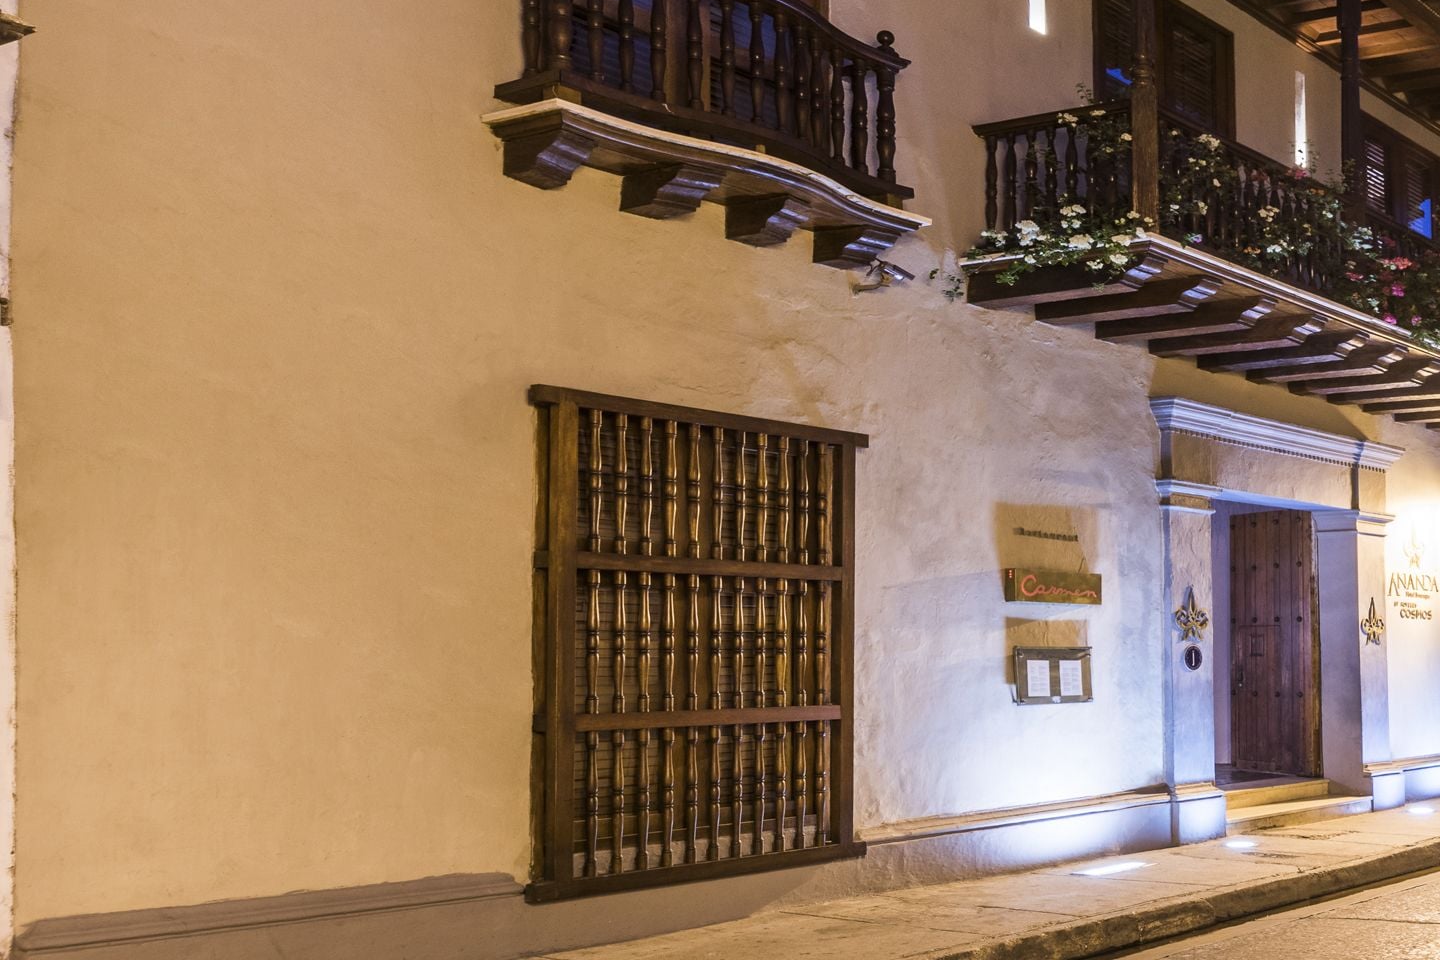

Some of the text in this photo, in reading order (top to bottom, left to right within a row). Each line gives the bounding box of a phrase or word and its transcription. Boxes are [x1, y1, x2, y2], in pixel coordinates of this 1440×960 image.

[1021, 574, 1097, 597] Carmen
[1387, 572, 1439, 597] ANANDA
[1399, 608, 1433, 621] COSMOS
